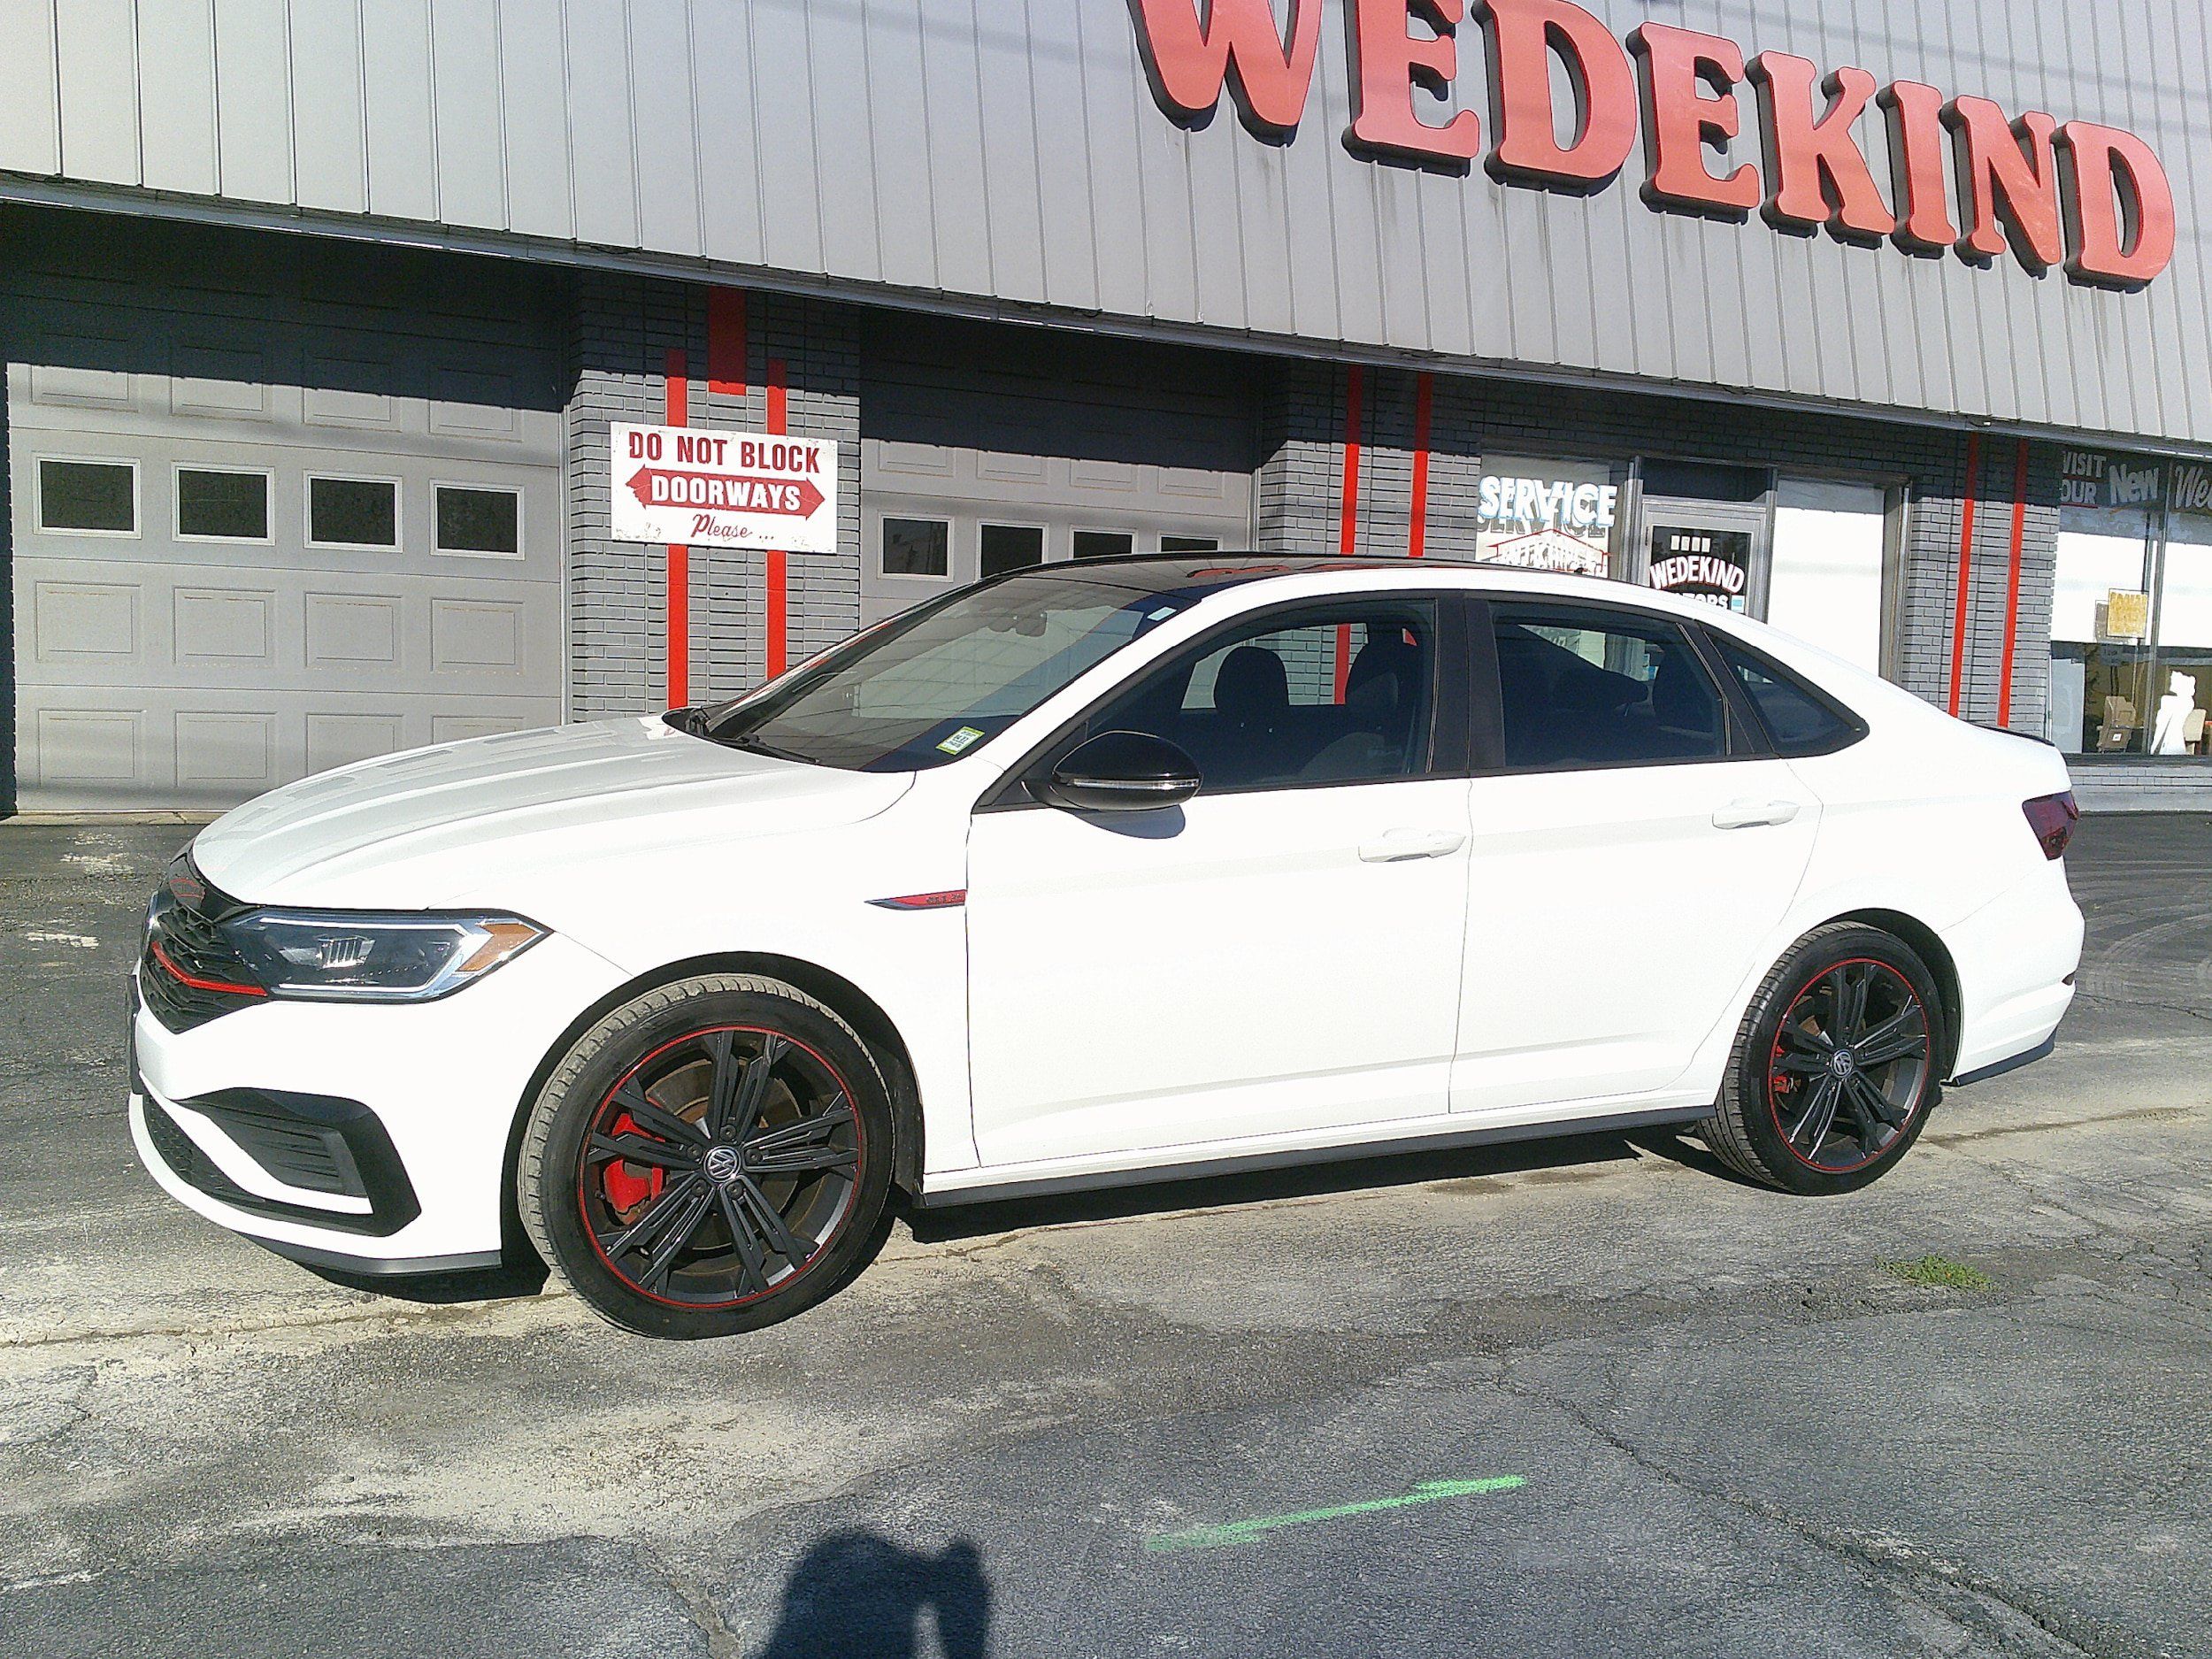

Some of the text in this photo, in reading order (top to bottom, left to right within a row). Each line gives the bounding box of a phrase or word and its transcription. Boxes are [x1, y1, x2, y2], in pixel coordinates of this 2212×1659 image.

[1138, 0, 2176, 288] WEDEKIND
[629, 431, 820, 473] DO NOT BLOCK
[2062, 450, 2107, 478] VISIT
[651, 475, 801, 511] DOORWAYS
[1478, 475, 1618, 527] SERVICE
[2175, 465, 2212, 510] We
[690, 513, 753, 538] Please
[1649, 555, 1745, 594] WEDEKIND
